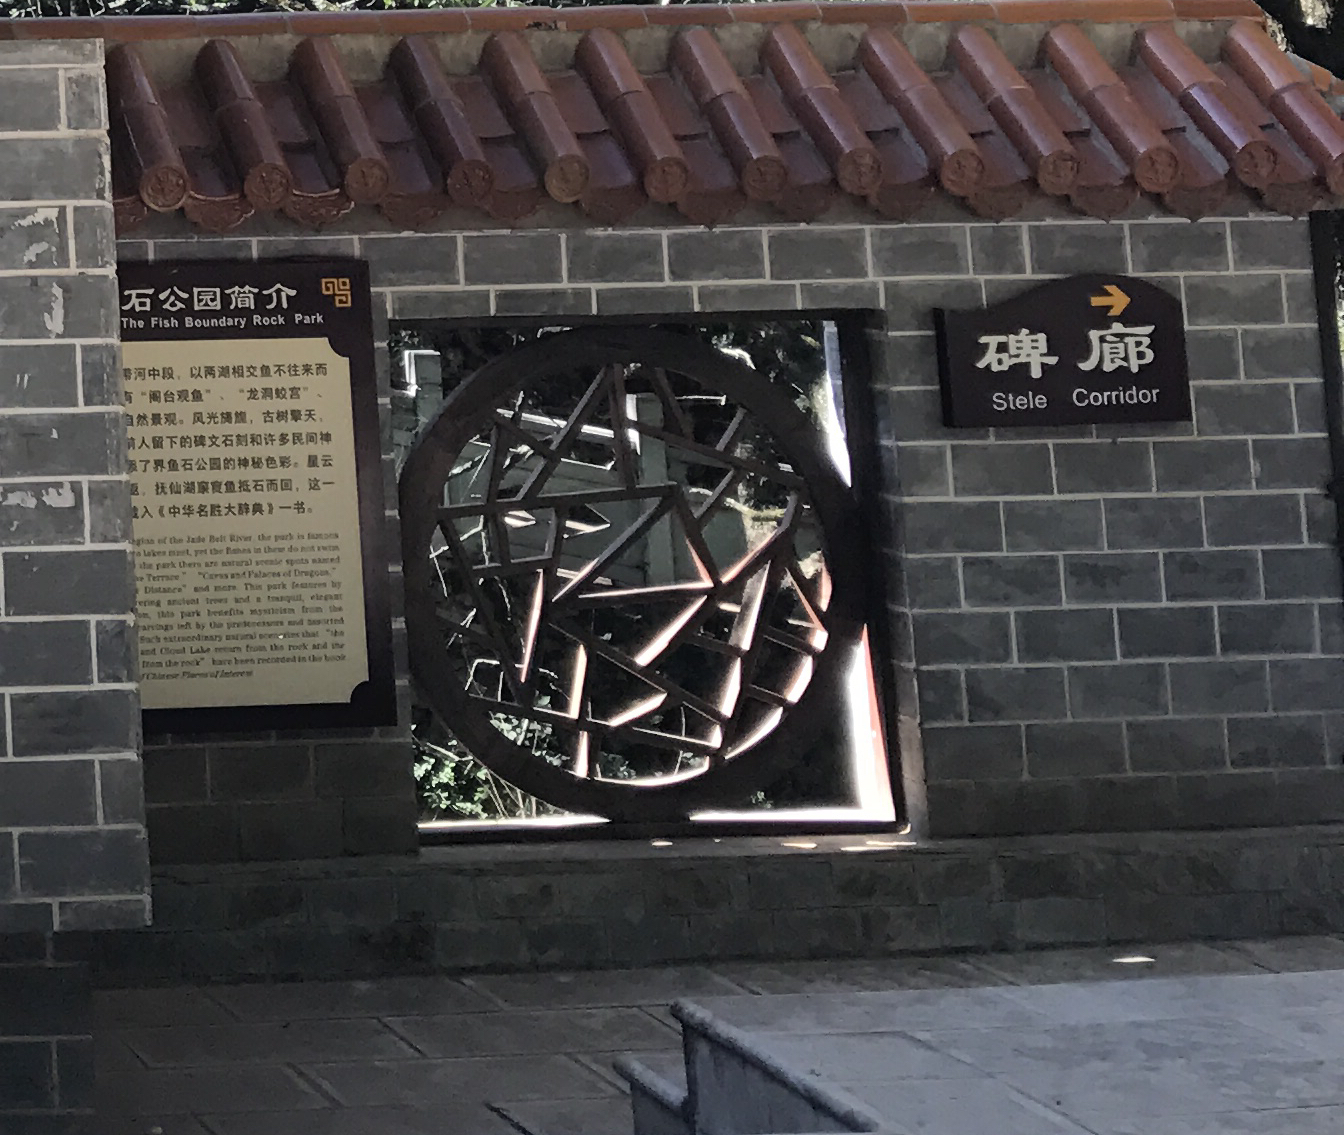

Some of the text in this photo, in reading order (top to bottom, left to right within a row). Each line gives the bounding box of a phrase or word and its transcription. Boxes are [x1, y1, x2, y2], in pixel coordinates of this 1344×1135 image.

[120, 282, 298, 312] 石公园简介
[121, 313, 325, 329] The Fish Boundary Rock Park
[975, 322, 1156, 379] 碑廊
[992, 386, 1160, 411] Stele Corridor
